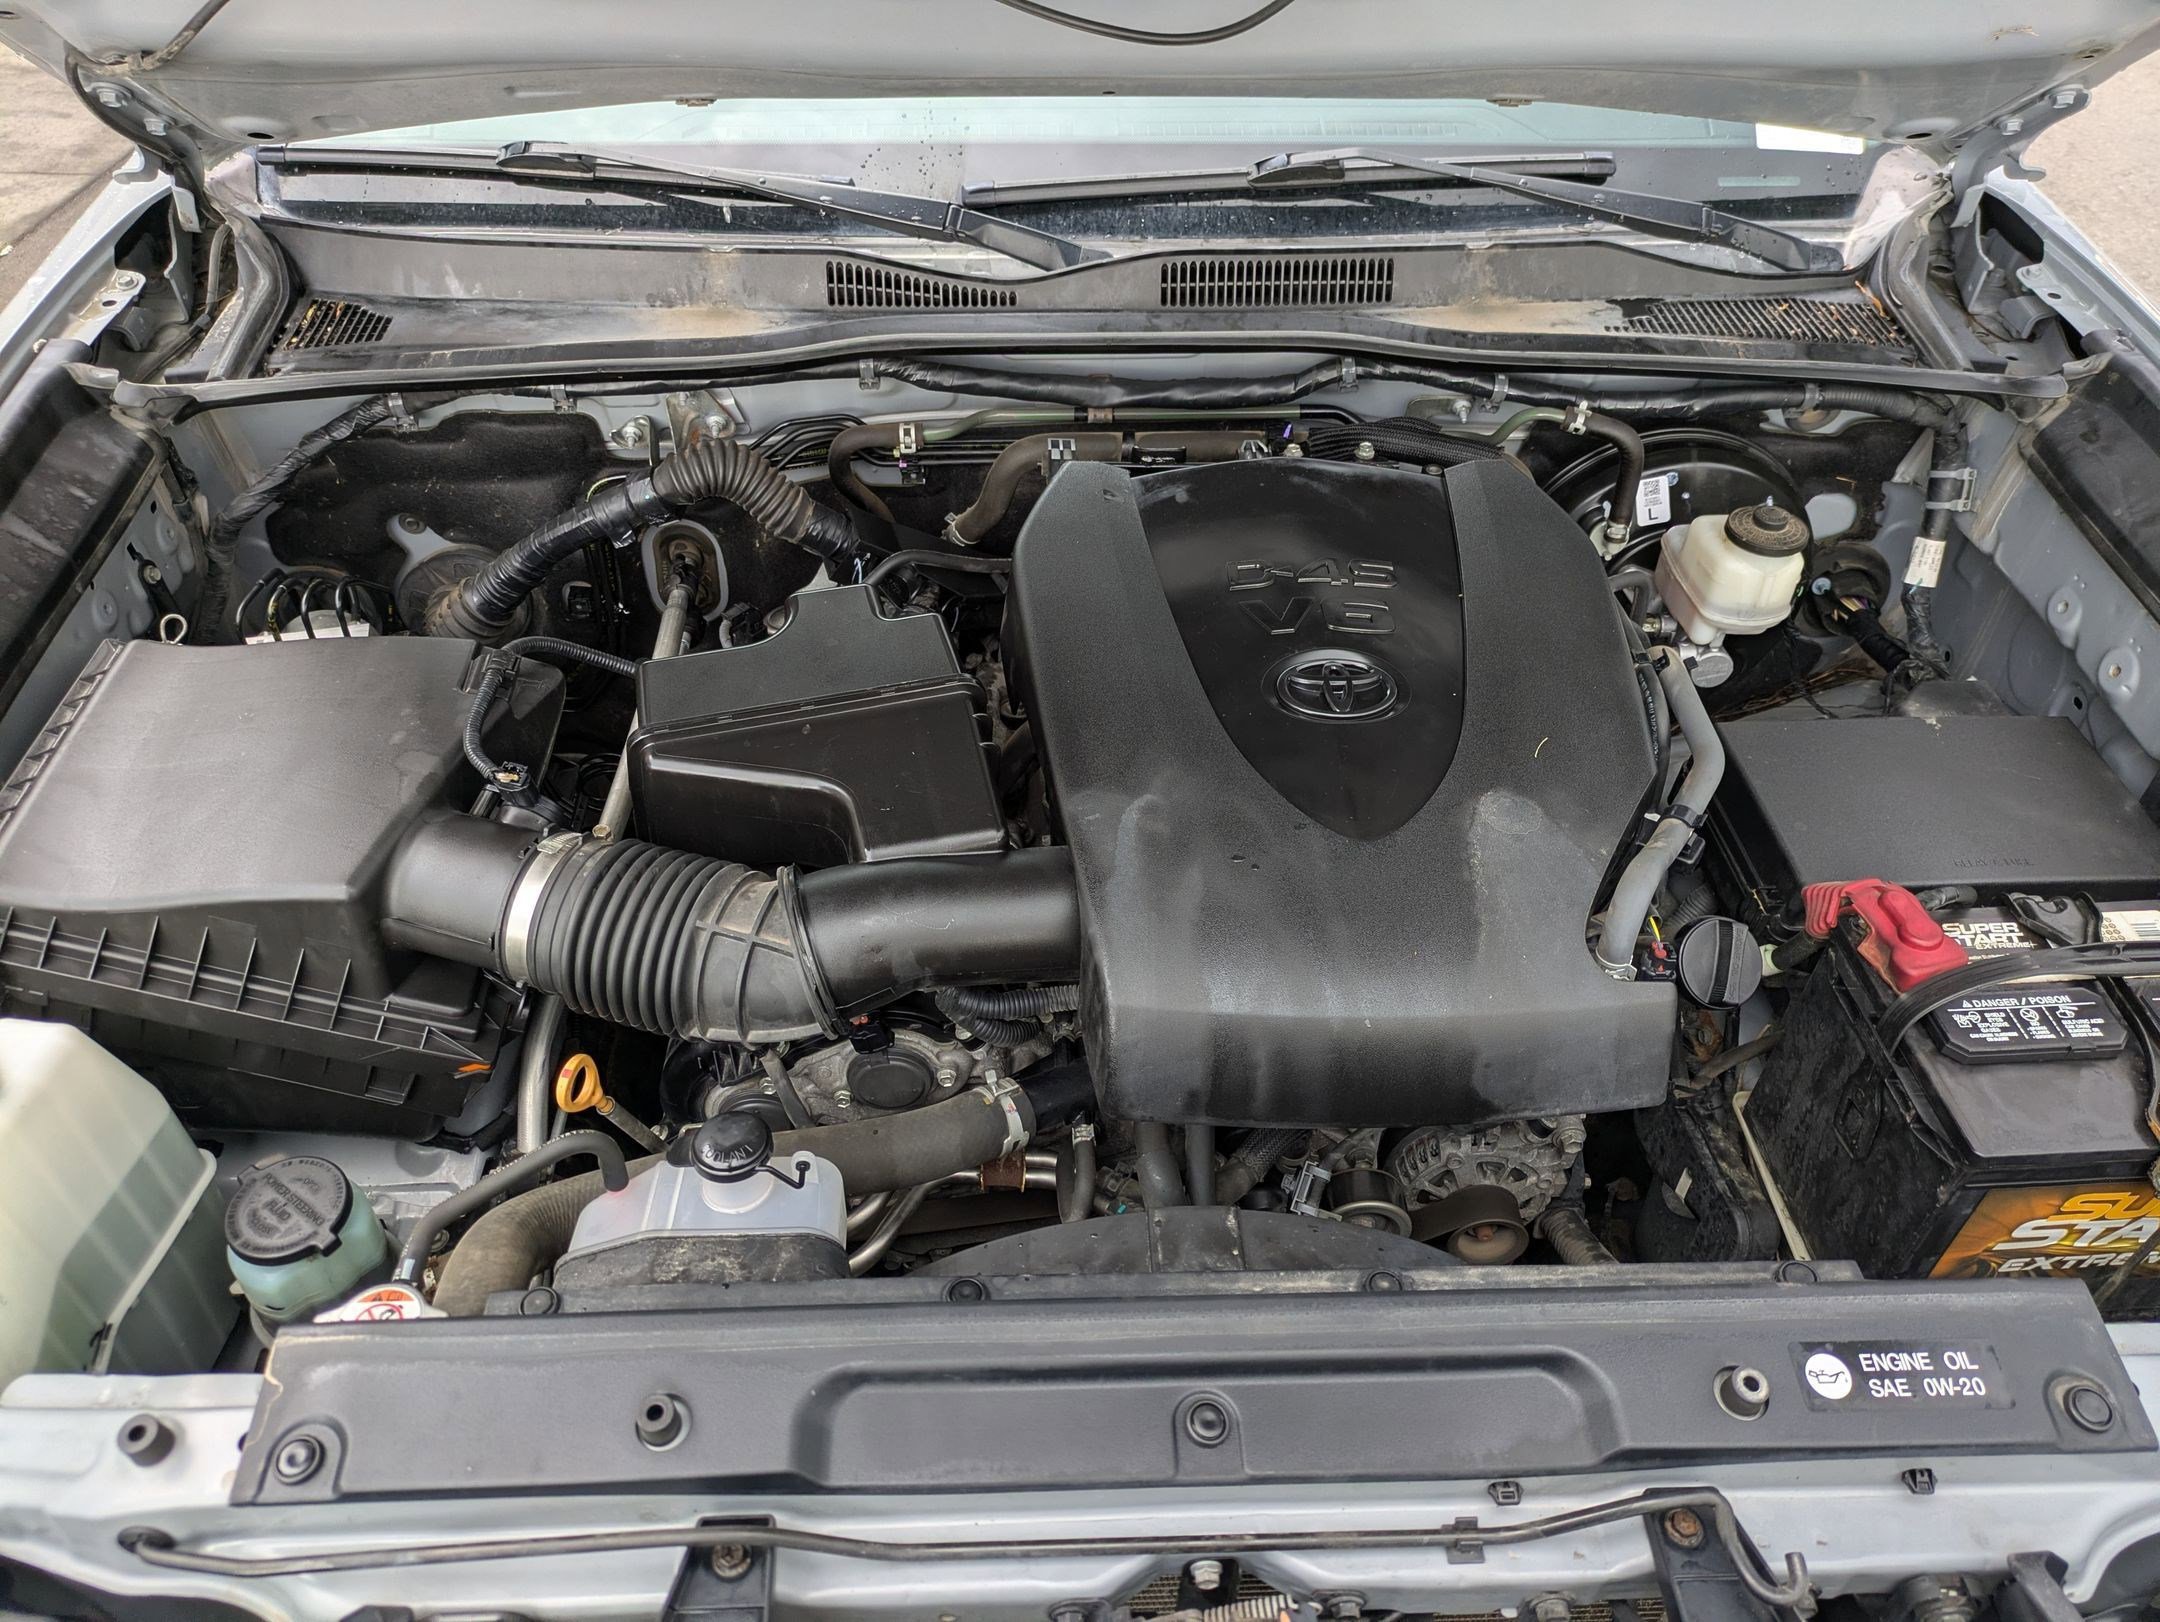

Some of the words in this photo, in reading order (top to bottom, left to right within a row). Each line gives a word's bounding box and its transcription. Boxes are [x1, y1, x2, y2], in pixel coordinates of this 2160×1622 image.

[1648, 508, 1659, 521] L
[1226, 558, 1398, 591] D-4S
[1238, 597, 1398, 635] V6
[1942, 922, 2019, 935] SUPER
[1973, 998, 2018, 1008] DANGER
[2029, 995, 2072, 1005] POISON
[701, 1143, 754, 1166] COOLANT
[263, 1172, 291, 1198] POWER
[286, 1191, 325, 1226] STEERING
[263, 1199, 291, 1221] FLUID
[1859, 1352, 1934, 1372] ENGINE
[1943, 1351, 1979, 1370] OIL
[1868, 1378, 1912, 1397] SAE
[1923, 1377, 1986, 1396] 0W-20
